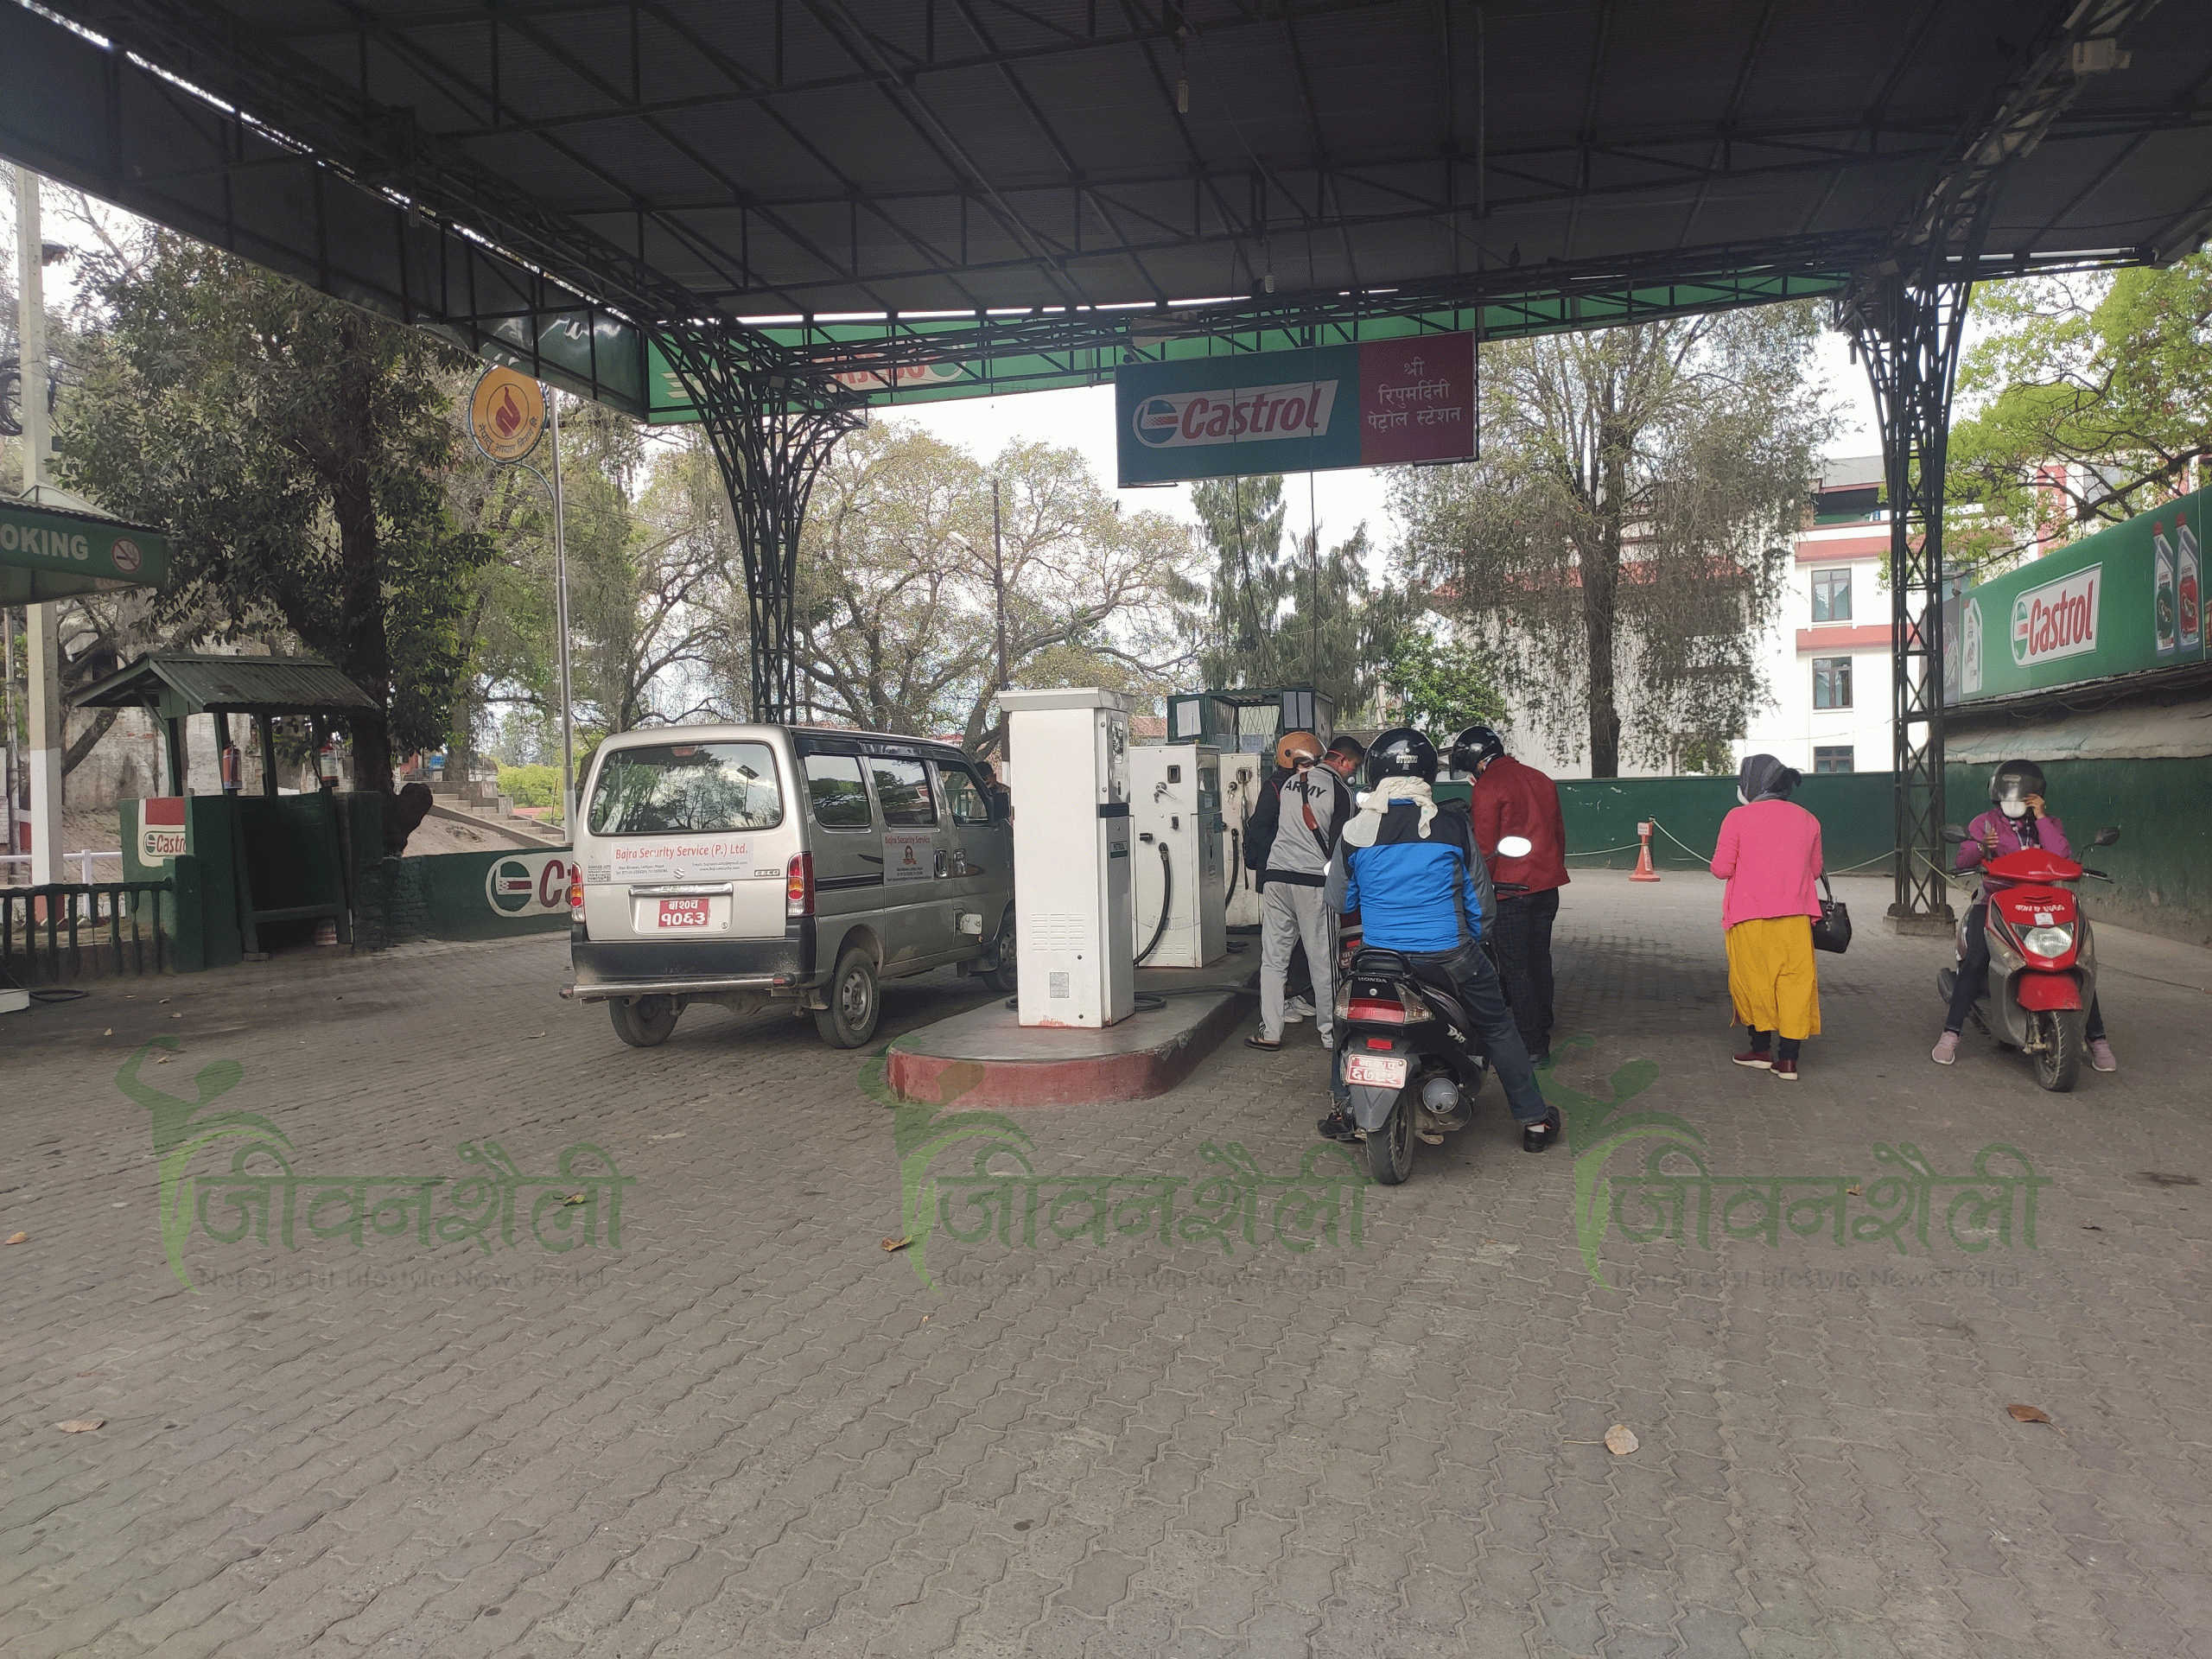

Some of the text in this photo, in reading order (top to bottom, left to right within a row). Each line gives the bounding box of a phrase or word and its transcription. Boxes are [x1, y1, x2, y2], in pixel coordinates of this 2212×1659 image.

[1403, 355, 1425, 377] श्री
[1378, 378, 1451, 409] रिपुमर्दिनी
[1181, 388, 1323, 440] Castrol
[1367, 405, 1462, 433] पेट्रोल स्टेशन
[0, 523, 89, 561] OKING
[2029, 578, 2094, 656] Castrol
[615, 842, 748, 862] Bajra Security Service (P.) Ltd.
[897, 836, 915, 846] Security
[915, 835, 931, 844] Service
[660, 912, 707, 926] १०६३
[1446, 1023, 1466, 1044] Dio
